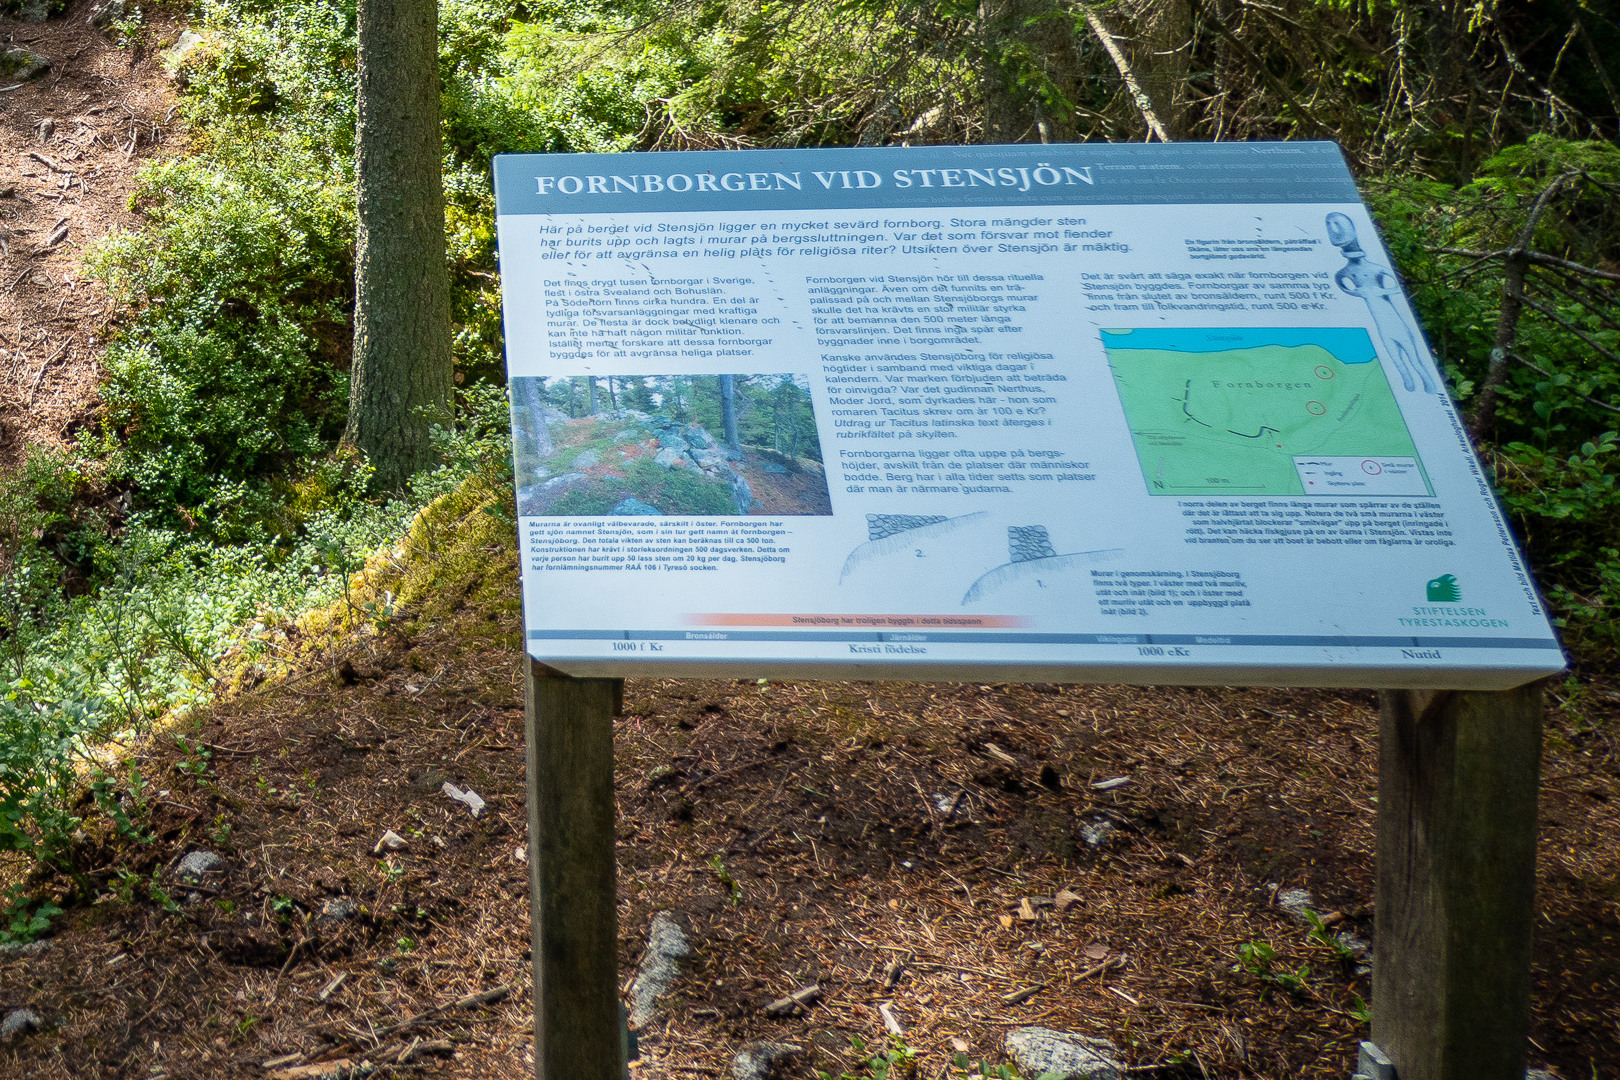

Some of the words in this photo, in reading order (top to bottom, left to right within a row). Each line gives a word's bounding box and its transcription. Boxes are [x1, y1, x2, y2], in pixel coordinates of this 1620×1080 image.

[534, 172, 802, 195] FORNBORGEN
[812, 170, 882, 190] VID
[893, 163, 1095, 192] STENSJÖN
[539, 225, 564, 234] Här
[566, 225, 583, 236] på
[587, 224, 629, 236] berget
[633, 224, 653, 233] vid
[657, 223, 715, 234] Stensjön
[719, 222, 757, 233] ligger
[781, 221, 829, 232] mycket
[833, 220, 879, 230] sevärd
[883, 219, 944, 231] fornborg.
[950, 218, 987, 228] Stora
[991, 217, 1053, 229] mängder
[1056, 217, 1087, 226] sten
[540, 238, 562, 247] har
[566, 237, 602, 247] burits
[606, 239, 631, 248] upp
[635, 236, 659, 246] och
[663, 236, 695, 247] lagts
[699, 236, 703, 245] i
[707, 237, 747, 245] murar
[751, 235, 768, 246] på
[772, 233, 888, 245] bergssluttningen.
[893, 232, 918, 242] Var
[921, 232, 943, 241] det
[980, 231, 1030, 240] försvar
[1033, 230, 1060, 240] mot
[1063, 230, 1113, 239] fiender
[541, 251, 571, 260] eller
[574, 250, 592, 259] för
[596, 250, 613, 259] att
[617, 249, 678, 261] avgränsa
[703, 248, 736, 260] helig
[740, 248, 773, 259] plats
[777, 247, 796, 257] för
[799, 247, 857, 258] religiösa
[861, 246, 897, 255] riter?
[902, 245, 958, 255] Utsikten
[962, 244, 994, 254] över
[997, 244, 1059, 255] Stensjön
[1063, 243, 1078, 253] är
[1081, 243, 1133, 254] mäktig.
[805, 275, 867, 286] Fornborgen
[868, 275, 885, 283] vid
[887, 274, 934, 285] Stensjön
[936, 274, 955, 282] hör
[956, 274, 970, 282] till
[972, 274, 1005, 282] dessa
[1007, 273, 1044, 281] rituella
[1080, 272, 1102, 281] Det
[1103, 272, 1115, 280] är
[1117, 272, 1146, 280] svårt
[1147, 272, 1163, 280] att
[1164, 272, 1193, 282] säga
[1194, 271, 1225, 280] exakt
[1227, 271, 1246, 279] när
[1247, 271, 1311, 281] fornborgen
[1311, 271, 1329, 279] vid
[543, 279, 561, 287] Det
[591, 278, 617, 288] drygt
[619, 278, 648, 286] tusen
[706, 277, 710, 285] i
[712, 277, 755, 287] Sverige,
[544, 289, 566, 297] flest
[568, 289, 572, 297] i
[603, 288, 651, 296] Svealand
[653, 288, 672, 296] och
[674, 287, 726, 295] Bohuslän.
[549, 350, 594, 360] byggdes
[596, 349, 610, 358] för
[613, 349, 627, 358] att
[630, 349, 678, 359] avgränsa
[681, 348, 713, 359] heliga
[716, 348, 755, 359] platser.
[820, 353, 862, 362] Kanske
[864, 353, 918, 361] användes
[919, 352, 987, 363] Stensjöborg
[988, 352, 1004, 360] för
[1006, 351, 1054, 362] religiösa
[1212, 380, 1311, 391] Fornborgen
[839, 449, 916, 460] Fornborgarna
[918, 449, 951, 460] ligger
[953, 449, 976, 458] ofta
[978, 451, 1008, 460] uppe
[1009, 449, 1026, 460] på
[1027, 449, 1065, 460] bergs-
[1153, 480, 1164, 489] N
[573, 521, 605, 529] ovanligt
[720, 521, 768, 529] Fornborgen
[1412, 606, 1486, 616] STIFTELSEN
[1398, 618, 1509, 628] TYRESTASKOGEN
[685, 631, 728, 640] Bronsålder
[612, 642, 636, 651] 1000
[650, 642, 664, 651] Kr
[848, 643, 881, 653] Kristi
[885, 643, 927, 654] födelse
[1137, 646, 1164, 656] 1000
[1401, 649, 1441, 659] Nutid
